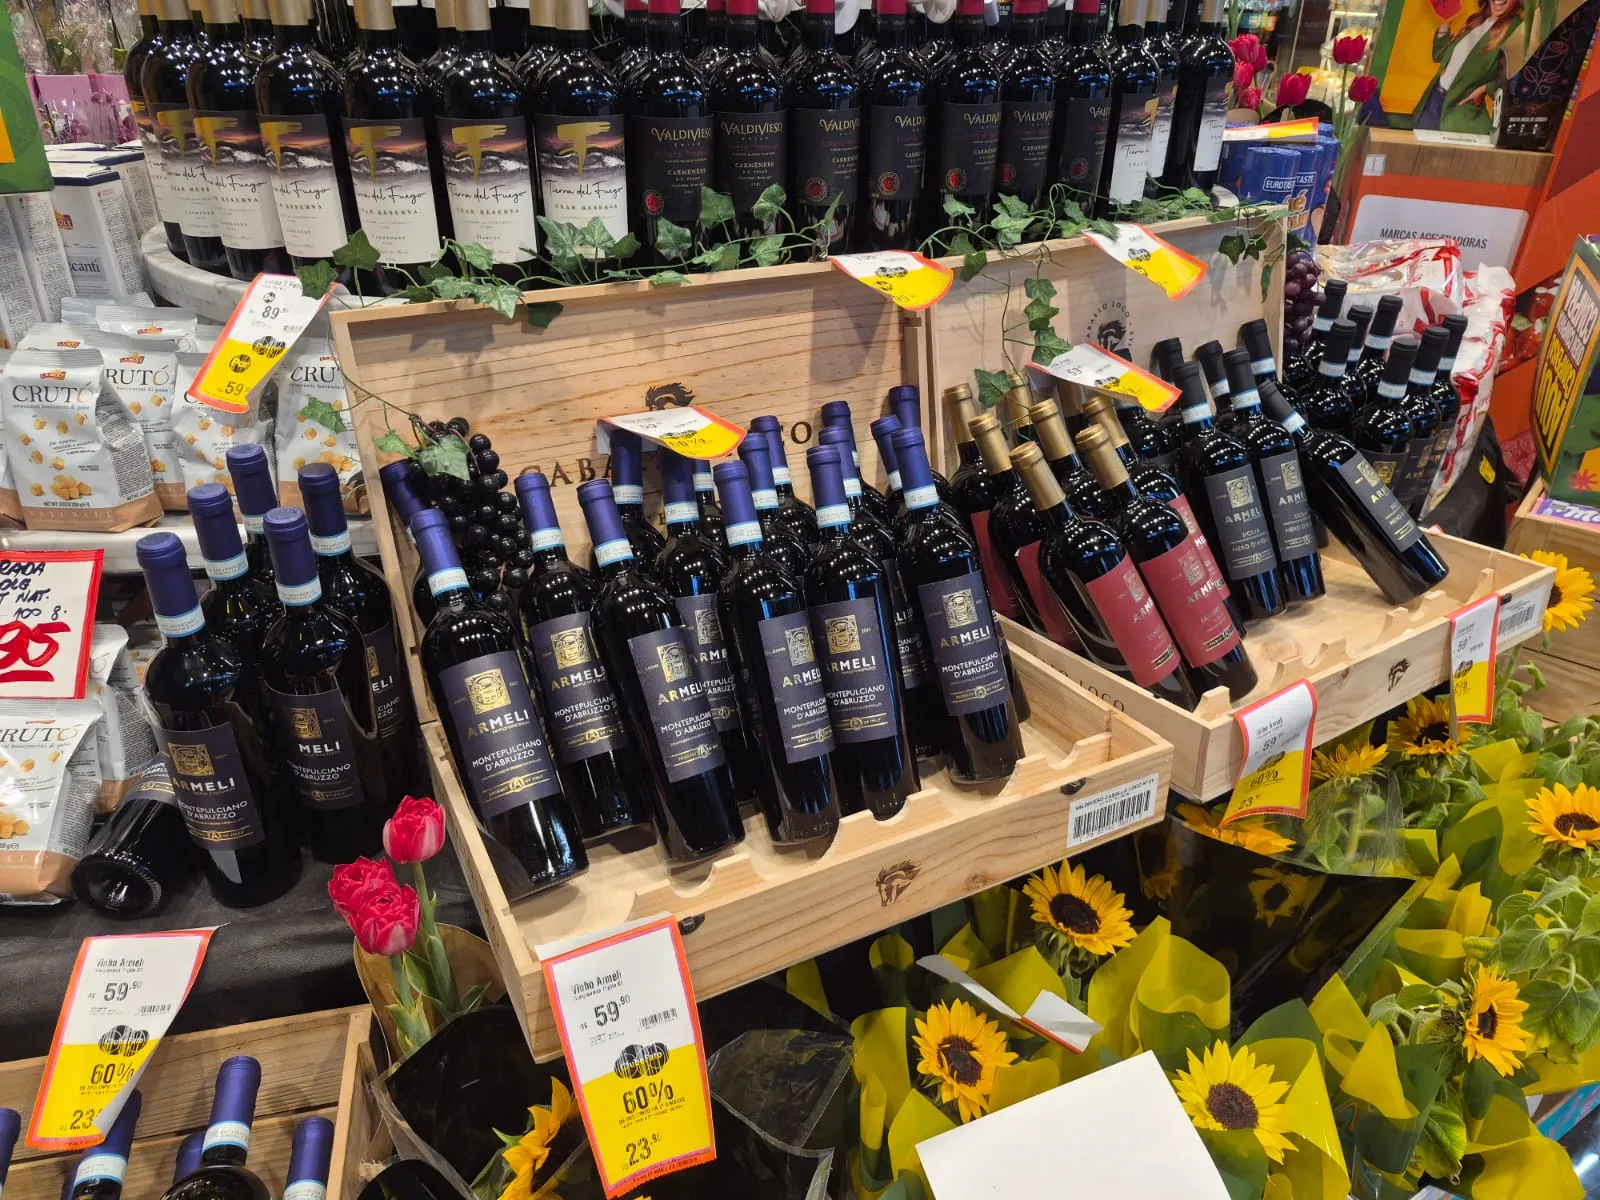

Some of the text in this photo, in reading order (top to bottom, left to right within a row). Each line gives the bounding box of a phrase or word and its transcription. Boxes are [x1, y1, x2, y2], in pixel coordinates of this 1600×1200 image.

[721, 122, 783, 136] VALDIVIESO
[386, 185, 427, 204] Fuego
[487, 185, 527, 204] Fuego
[594, 181, 623, 200] Fuego
[105, 365, 169, 386] RUTÓ
[290, 366, 339, 383] CRU
[12, 381, 94, 402] CRUTÓ
[1225, 507, 1260, 525] ARMEL
[940, 625, 990, 649] ARMELI
[942, 651, 998, 673] MONTEPULCIANO
[954, 662, 994, 678] D'ABRUZZO
[834, 694, 876, 706] D'ABRUZZO
[565, 704, 611, 722] D'ABRUZZO
[0, 723, 83, 743] RUTÓ
[468, 709, 529, 739] ARMELI
[472, 738, 542, 768] MONTEPULCIANO
[485, 749, 535, 772] D'ABRUZZO
[289, 761, 351, 775] NTEPULCIANO
[91, 1062, 135, 1085] 60%
[623, 1079, 674, 1115] 60%
